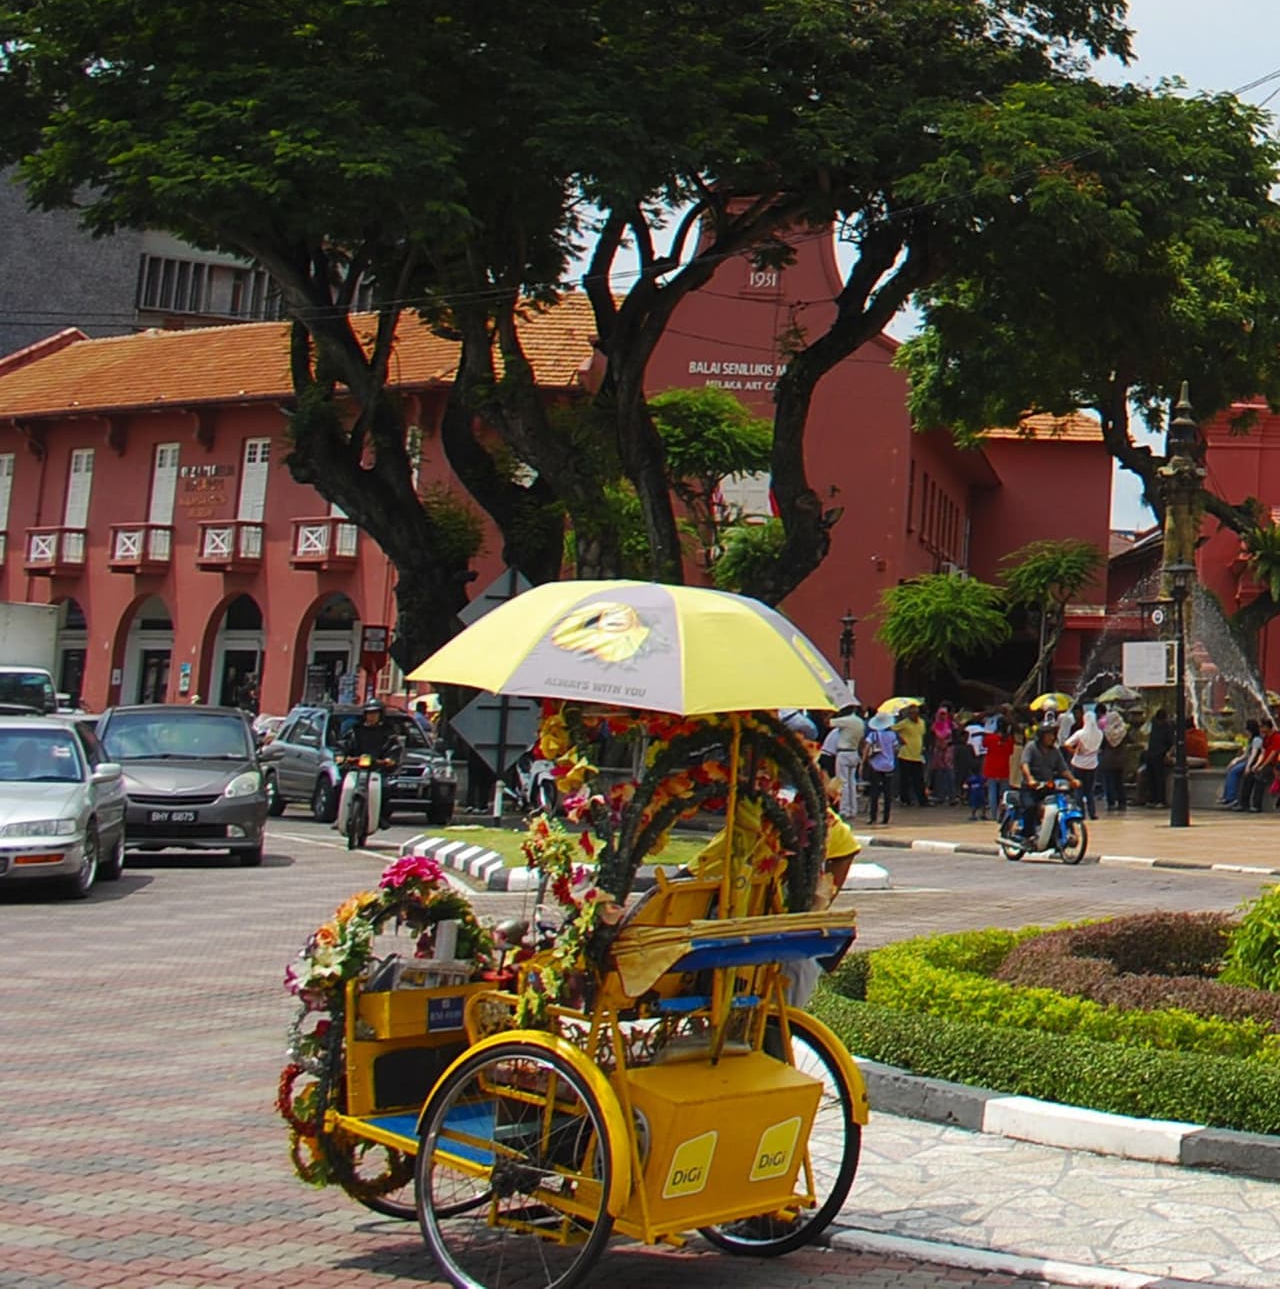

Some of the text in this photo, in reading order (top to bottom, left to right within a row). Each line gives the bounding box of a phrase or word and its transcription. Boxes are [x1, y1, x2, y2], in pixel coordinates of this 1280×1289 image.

[689, 361, 720, 374] BALAI
[544, 677, 590, 691] ALWAYS
[624, 687, 647, 697] YOU
[671, 1167, 702, 1186] DiGi
